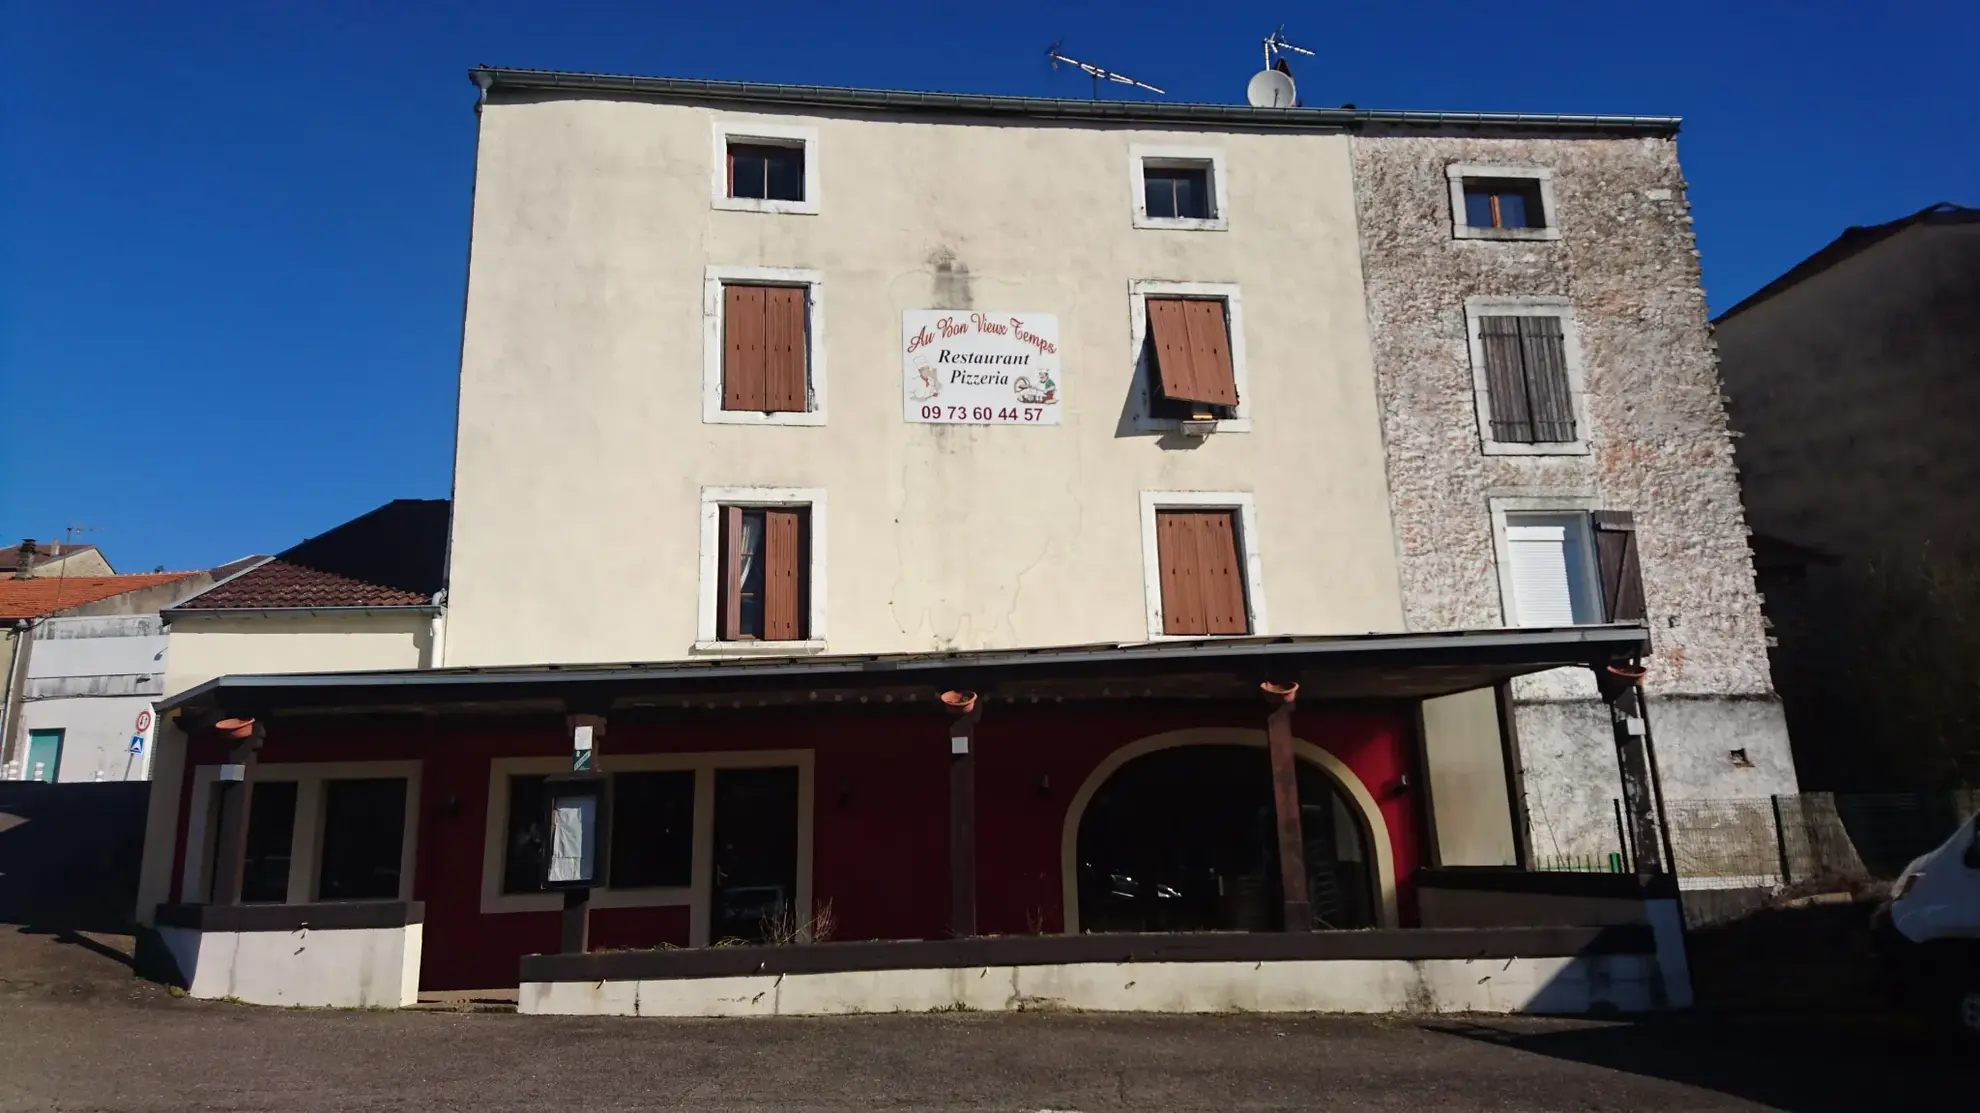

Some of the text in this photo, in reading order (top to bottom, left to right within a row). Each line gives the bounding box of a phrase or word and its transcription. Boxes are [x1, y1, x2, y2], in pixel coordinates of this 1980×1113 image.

[907, 313, 1057, 355] Au Bon Vieux Temps
[938, 349, 1030, 365] Restaurant
[950, 370, 1009, 385] Pizzeria
[921, 406, 1043, 421] 09 73 60 44 57
